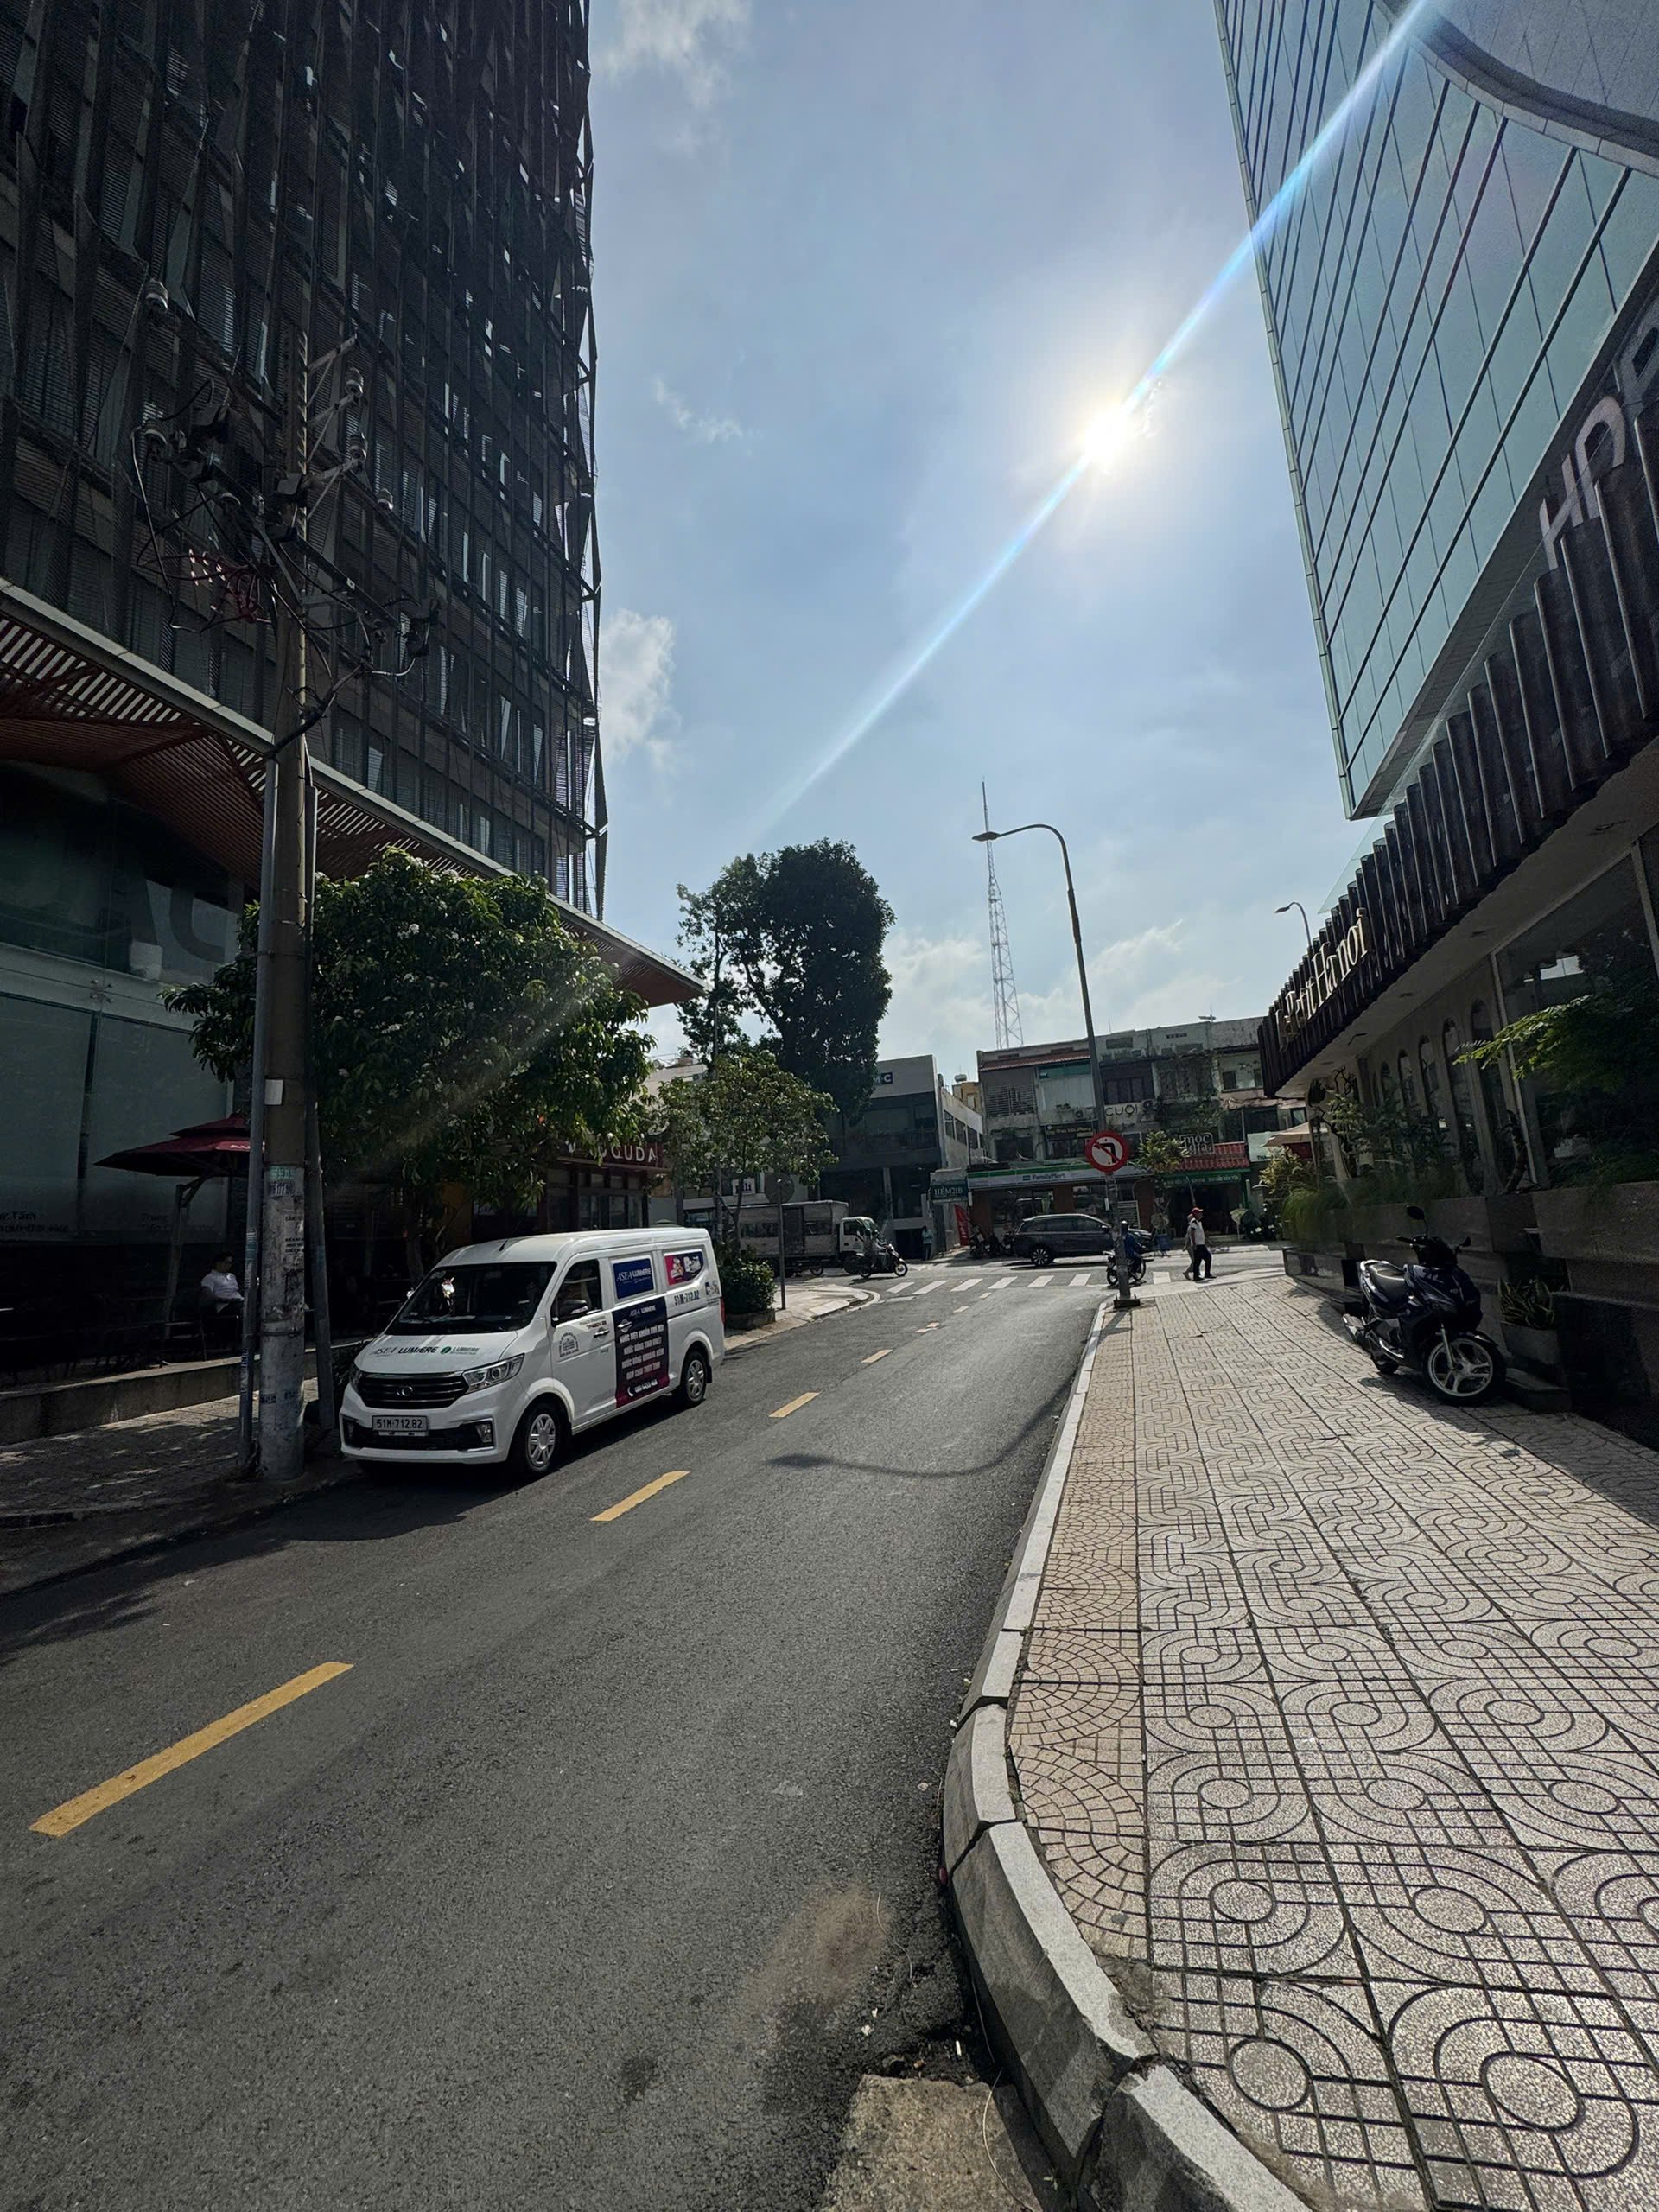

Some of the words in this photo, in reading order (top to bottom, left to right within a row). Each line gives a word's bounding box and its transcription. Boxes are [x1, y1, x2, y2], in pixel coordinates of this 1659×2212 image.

[1311, 907, 1369, 1009] Hanoi
[1033, 1173, 1065, 1181] FamilyMart
[376, 1419, 423, 1429] 51M-712.82
